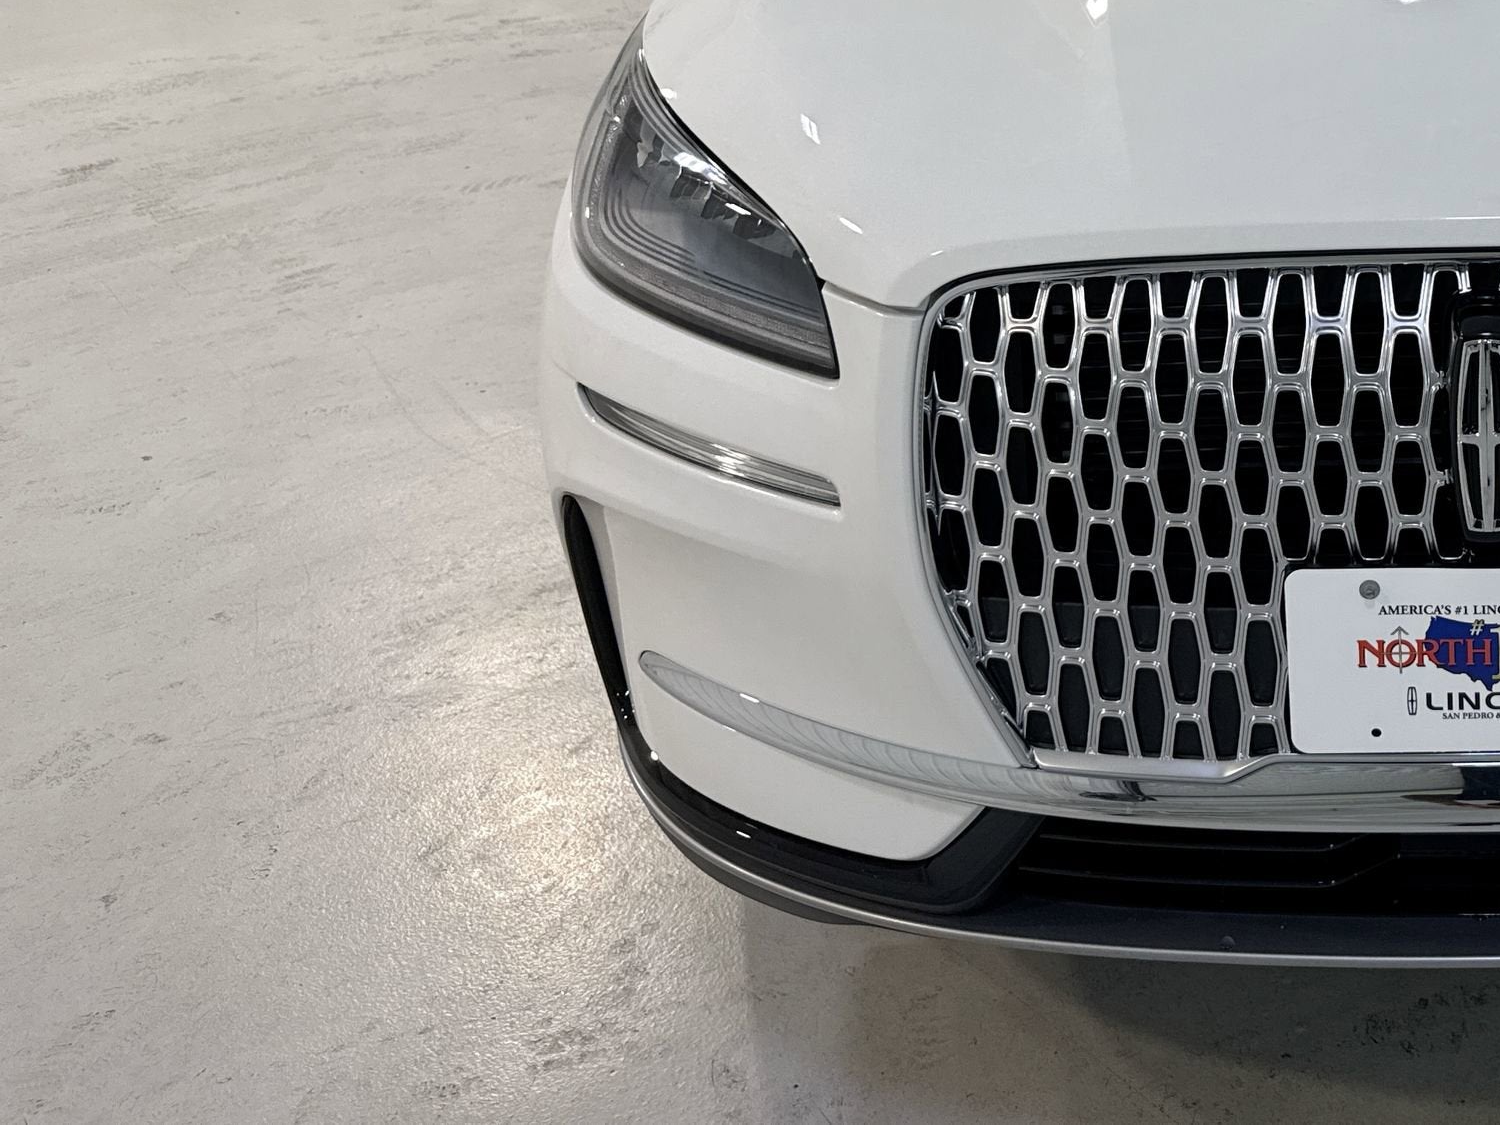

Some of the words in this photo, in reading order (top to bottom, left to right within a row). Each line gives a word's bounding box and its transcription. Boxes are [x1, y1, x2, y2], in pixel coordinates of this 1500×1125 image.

[1378, 603, 1452, 616] AMERICA'S
[1455, 604, 1469, 615] #1
[1356, 637, 1492, 668] NORTH
[1442, 712, 1461, 720] SAN
